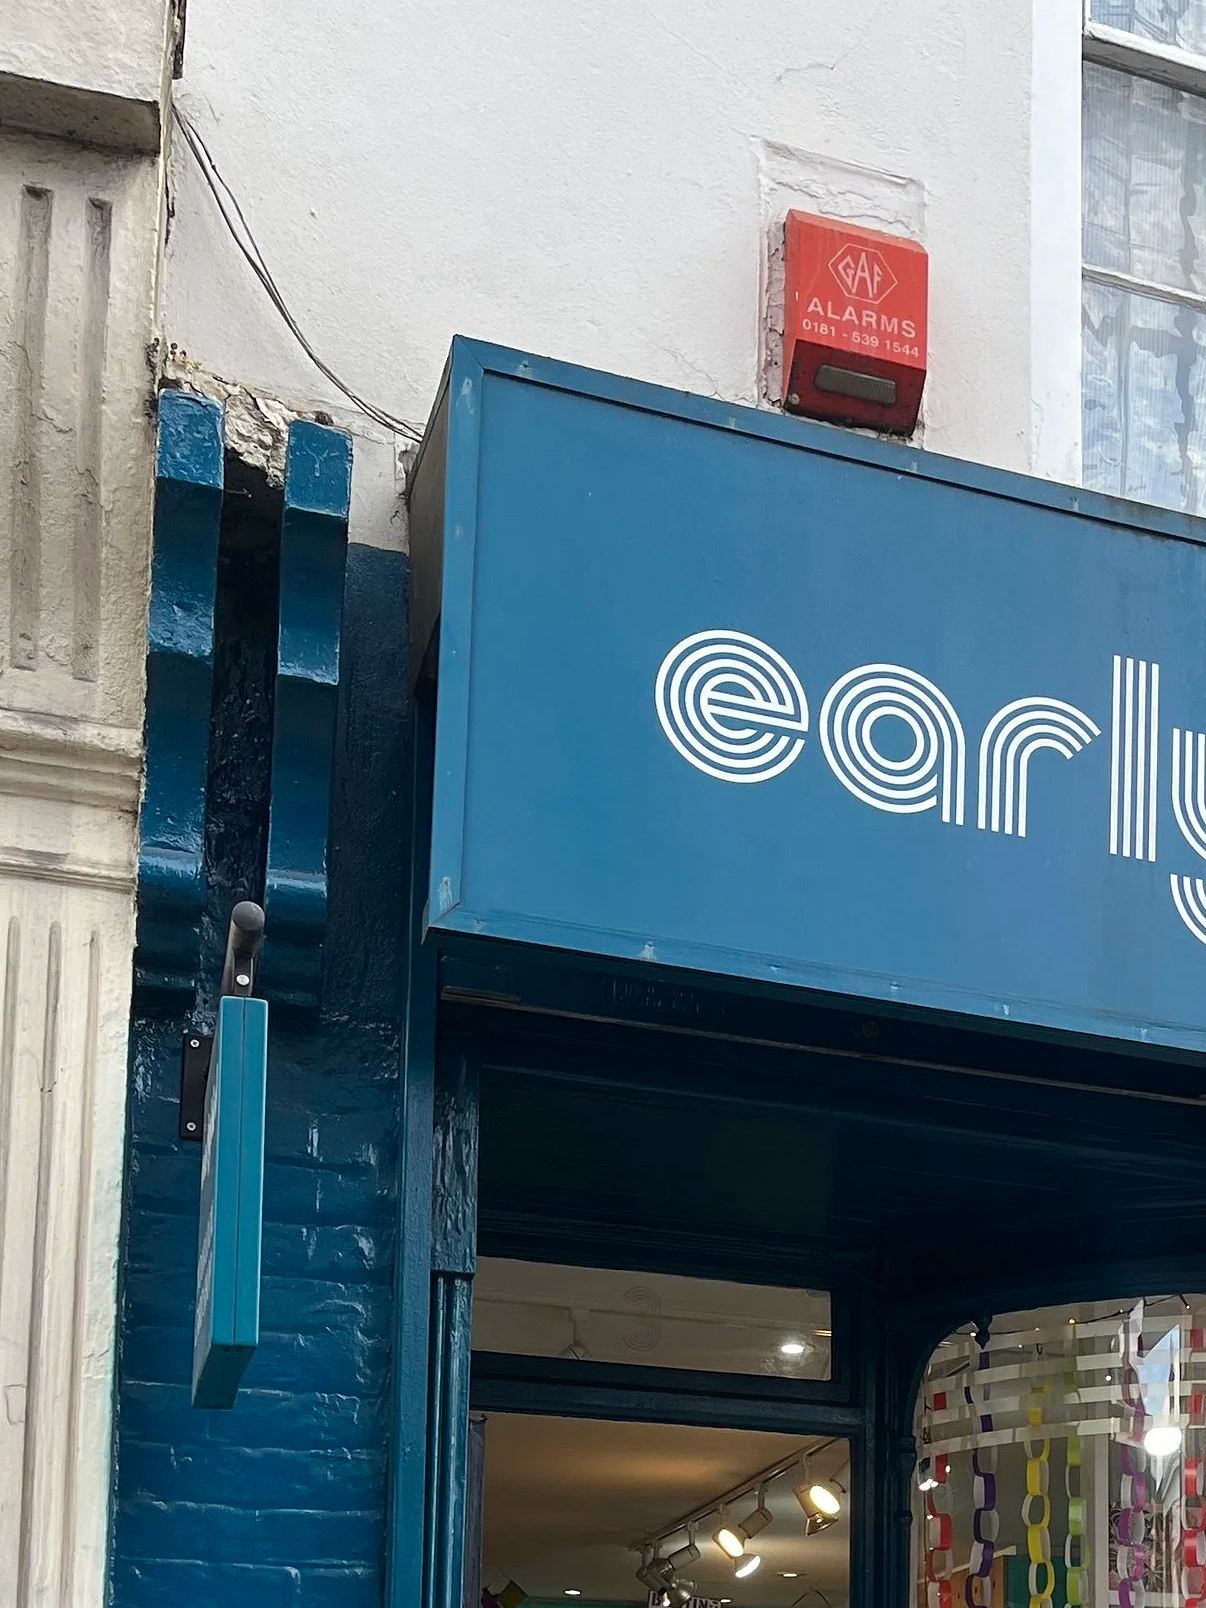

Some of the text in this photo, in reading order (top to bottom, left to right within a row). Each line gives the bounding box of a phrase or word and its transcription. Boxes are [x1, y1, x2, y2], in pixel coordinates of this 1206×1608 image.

[802, 318, 837, 337] 0181
[852, 331, 879, 347] 539
[884, 339, 919, 358] 1544
[807, 297, 916, 339] ALARMS
